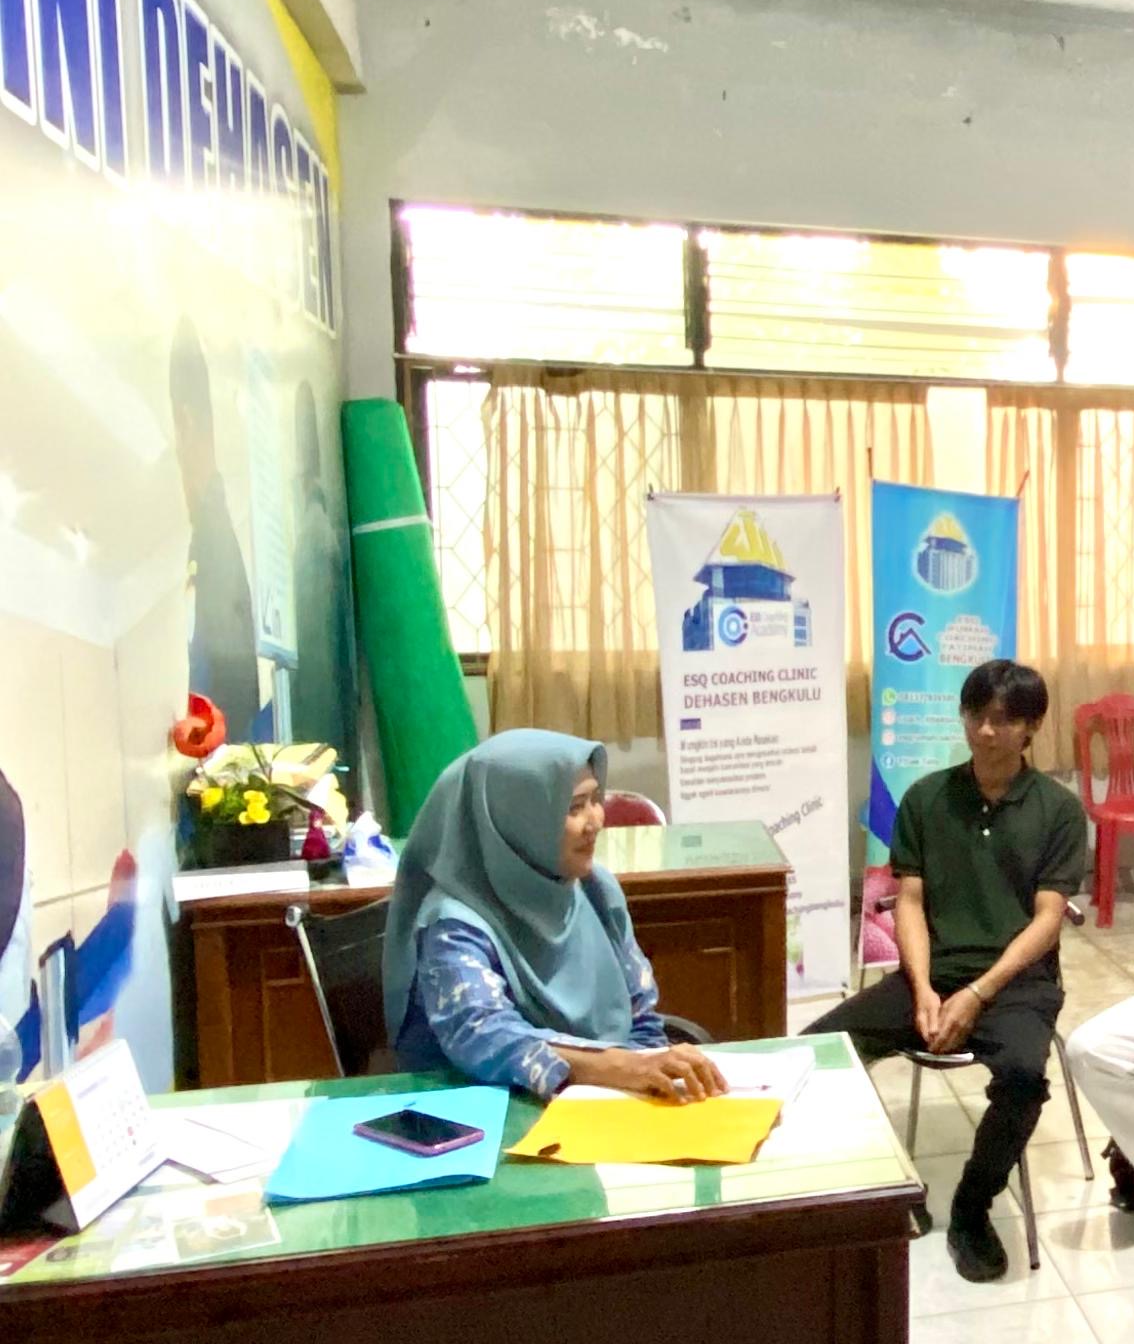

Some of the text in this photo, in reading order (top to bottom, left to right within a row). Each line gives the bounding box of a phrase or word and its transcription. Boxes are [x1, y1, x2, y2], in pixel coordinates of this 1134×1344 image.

[683, 667, 818, 688] ESQ COACHING CLINIC
[684, 688, 822, 709] DEHASEN BENGKULU
[768, 795, 824, 834] oaching Clinic
